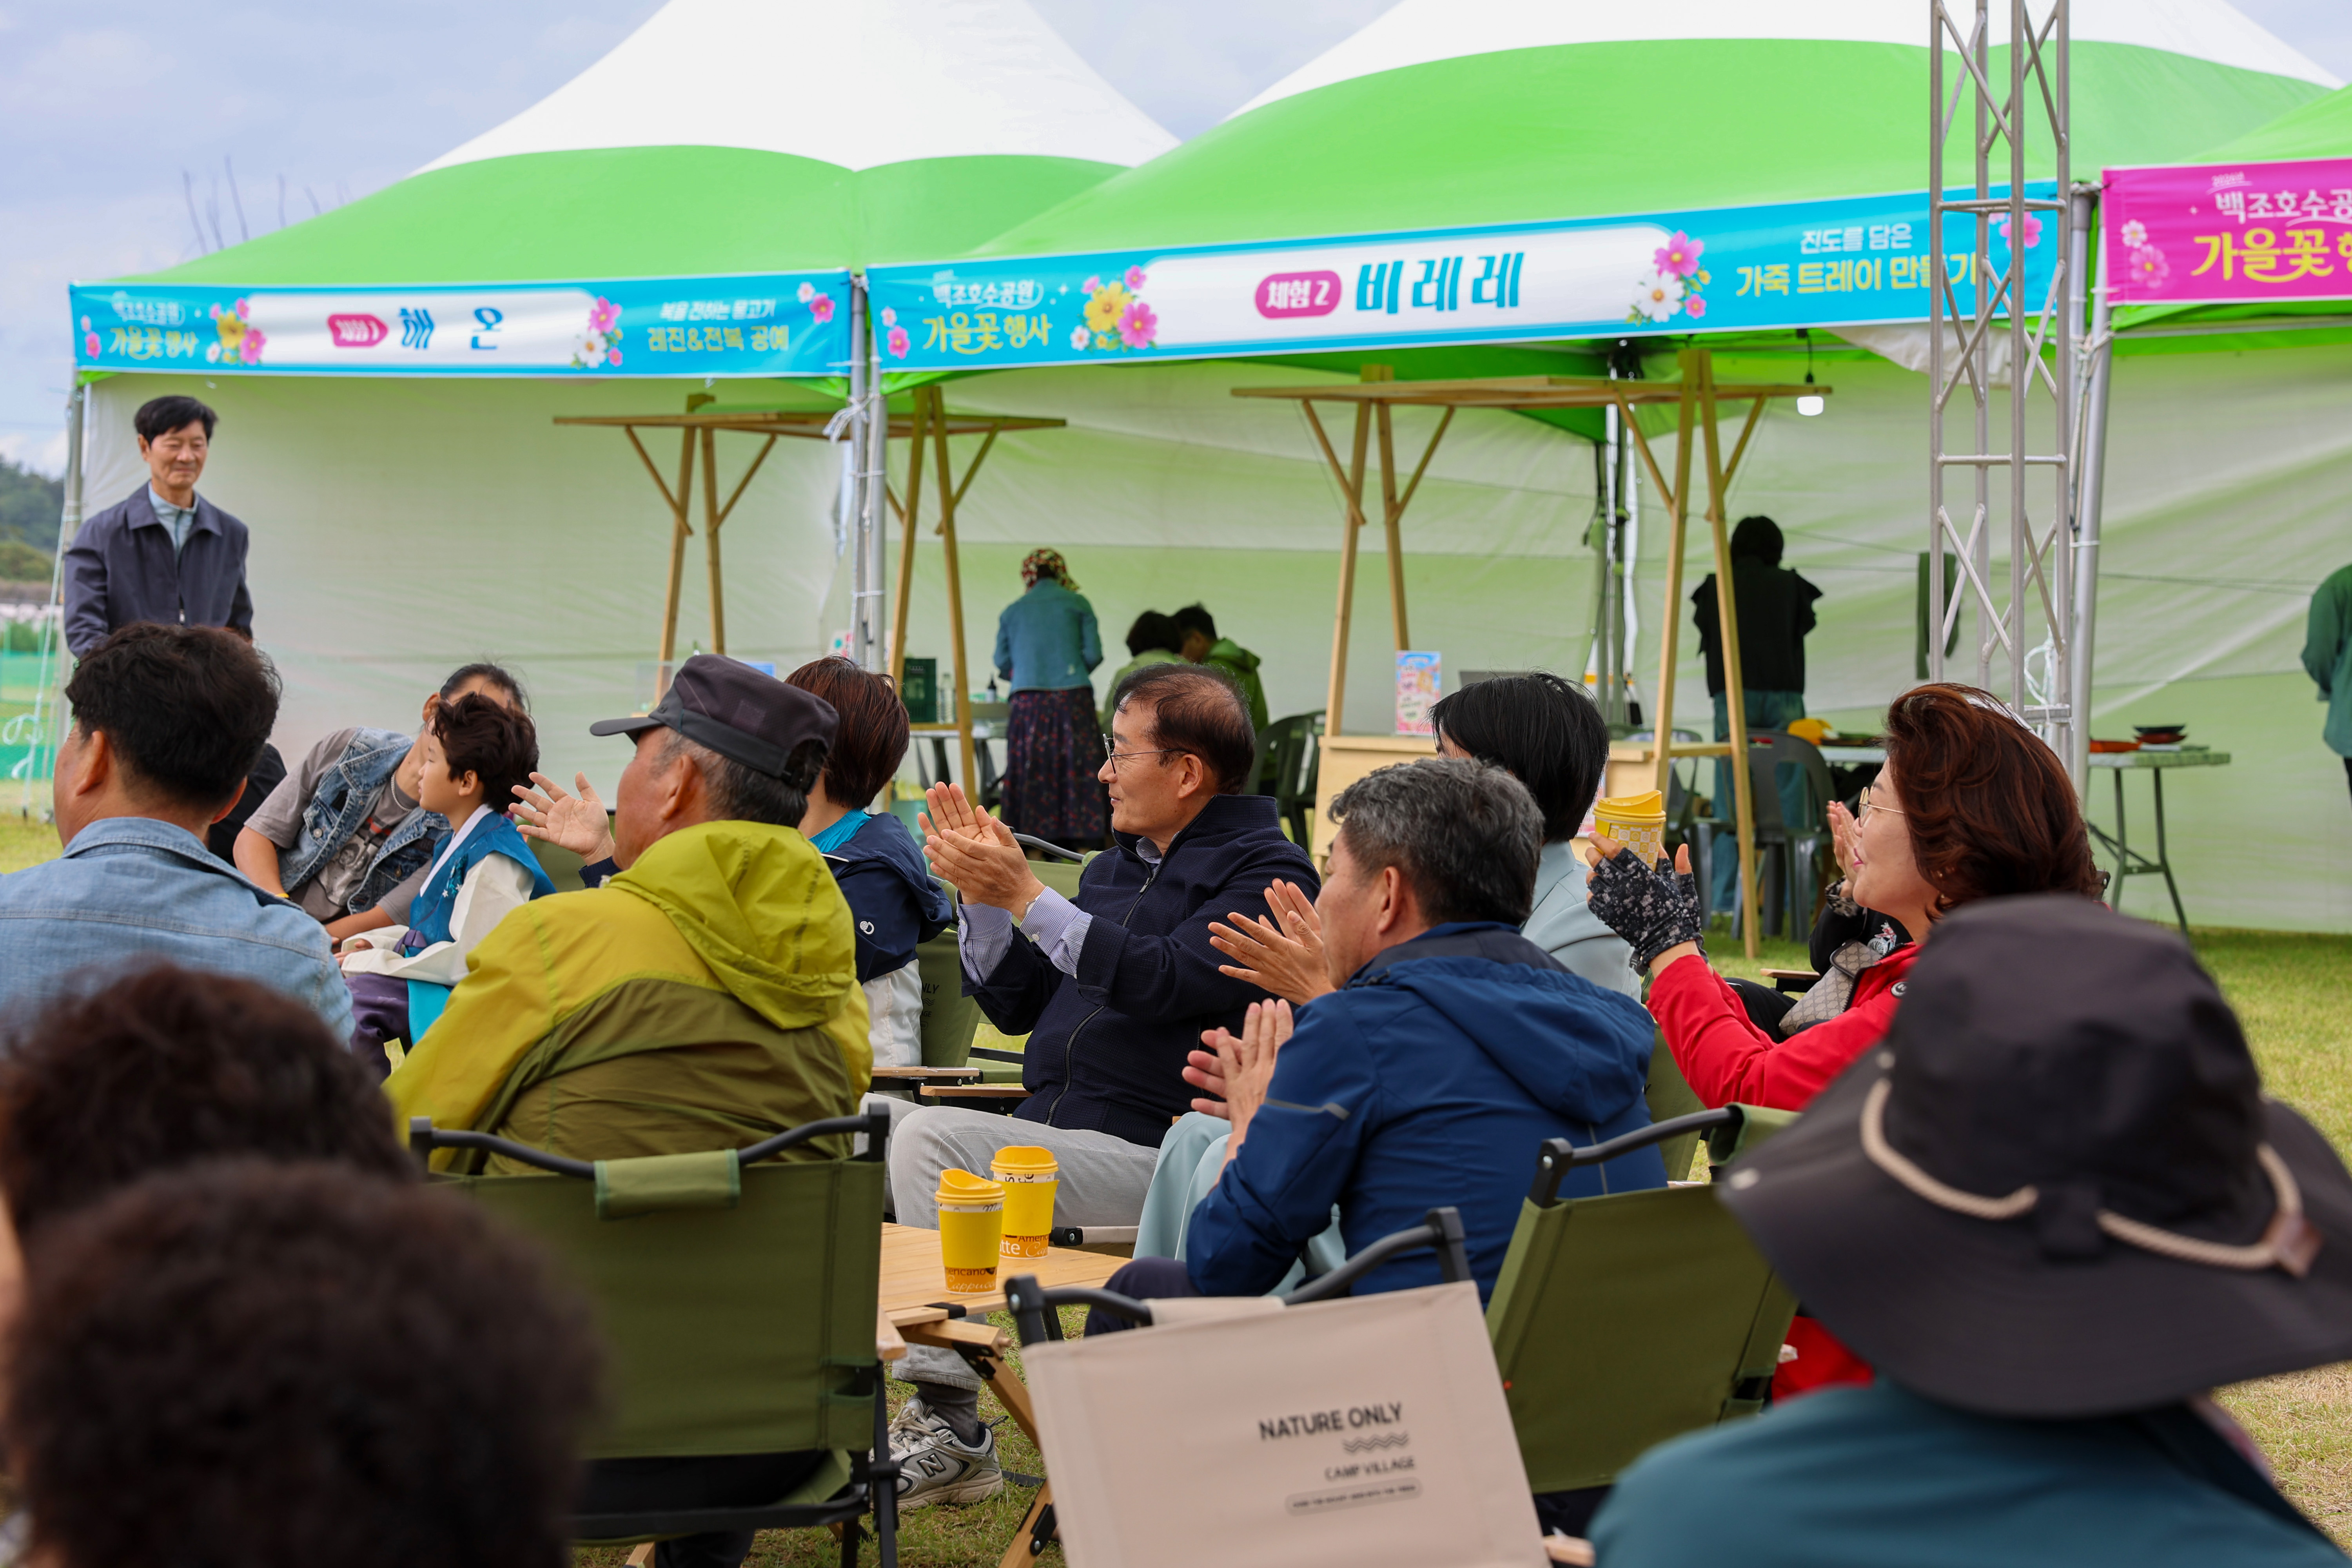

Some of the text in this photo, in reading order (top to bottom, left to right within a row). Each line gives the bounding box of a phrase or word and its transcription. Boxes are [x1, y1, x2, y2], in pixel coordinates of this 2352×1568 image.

[2215, 189, 2352, 224] 백조호수공
[1800, 223, 1913, 254] 진도를 담은
[2190, 227, 2335, 283] 가을꽃
[1265, 279, 1330, 310] 체험 2
[1355, 252, 1524, 314] 비레레
[1735, 262, 1790, 297] 가죽
[1797, 258, 1881, 294] 트레이
[750, 325, 789, 352] 공예
[922, 312, 1053, 355] 가을꽃 행사
[922, 982, 940, 994] NLY
[1259, 1401, 1403, 1441] NATURE ONLY
[1324, 1455, 1415, 1482] CAMP VILLAGE
